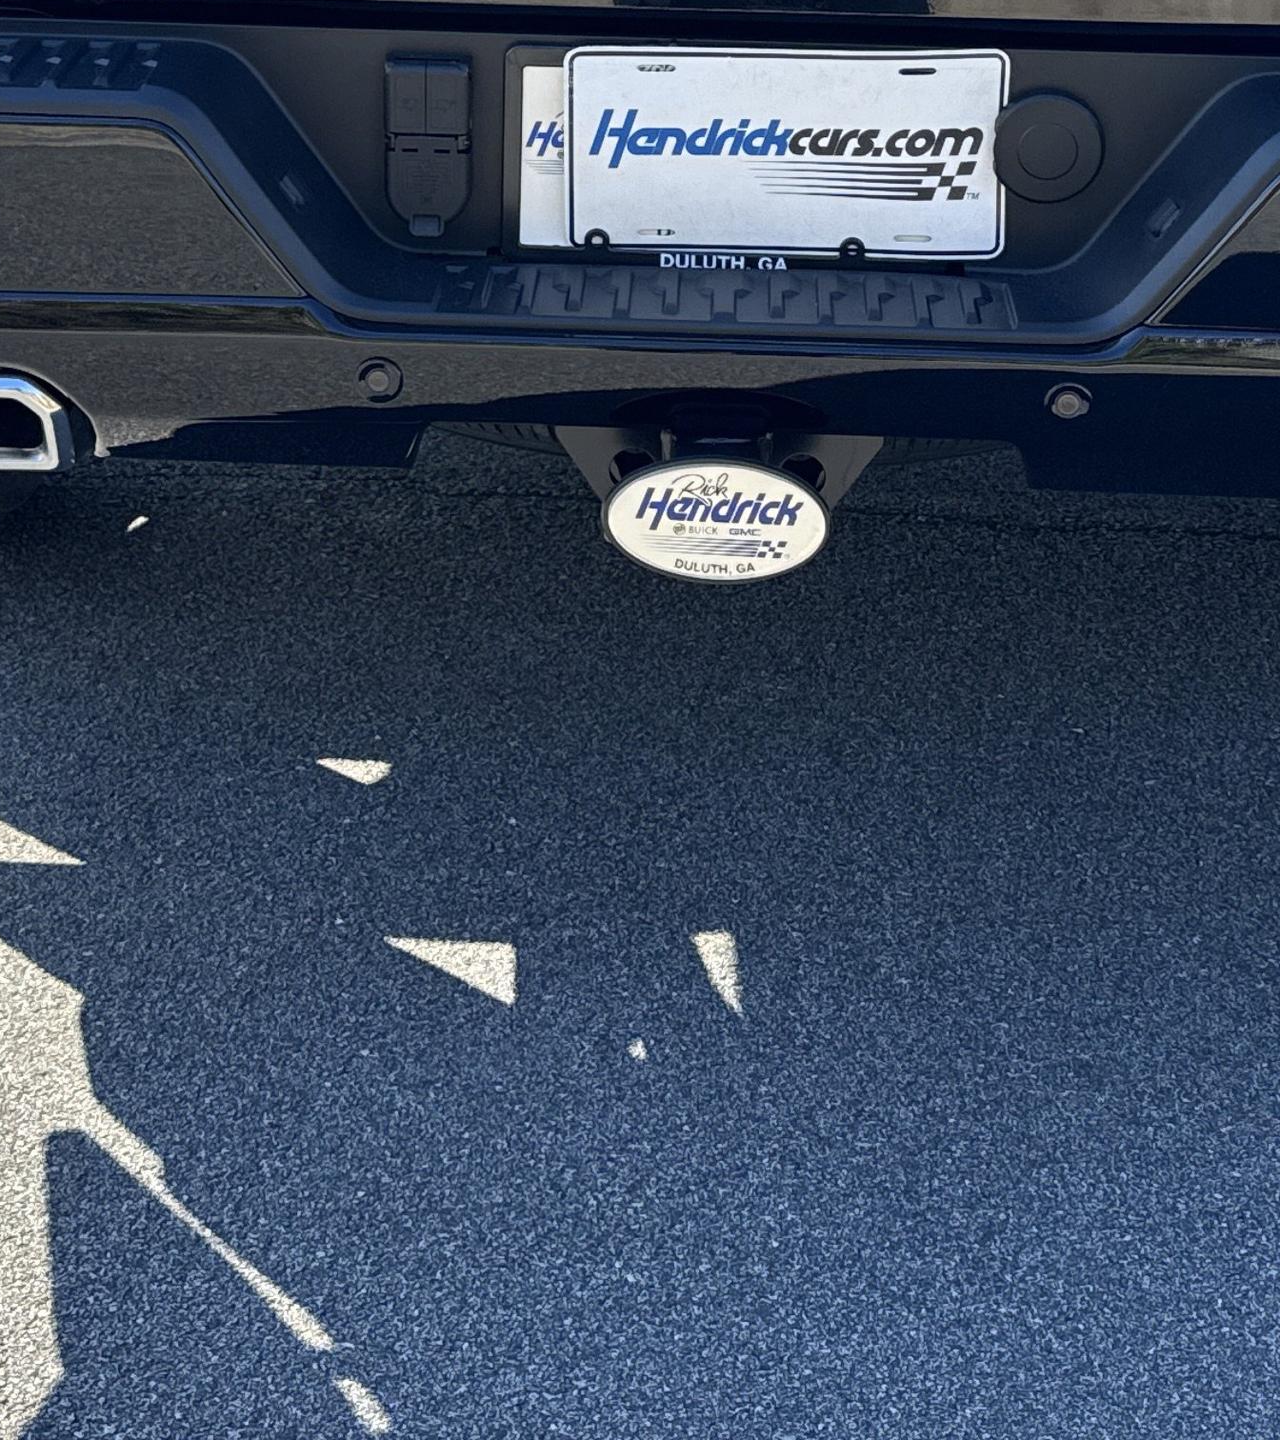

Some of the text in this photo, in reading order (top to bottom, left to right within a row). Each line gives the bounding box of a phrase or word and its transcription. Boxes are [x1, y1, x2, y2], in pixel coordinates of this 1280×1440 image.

[589, 108, 984, 169] Hendrickcars.com
[758, 256, 788, 271] GA
[671, 472, 729, 504] Rick
[635, 486, 804, 530] Hendrick
[688, 525, 762, 537] BUICK GMC
[736, 564, 756, 574] GA
